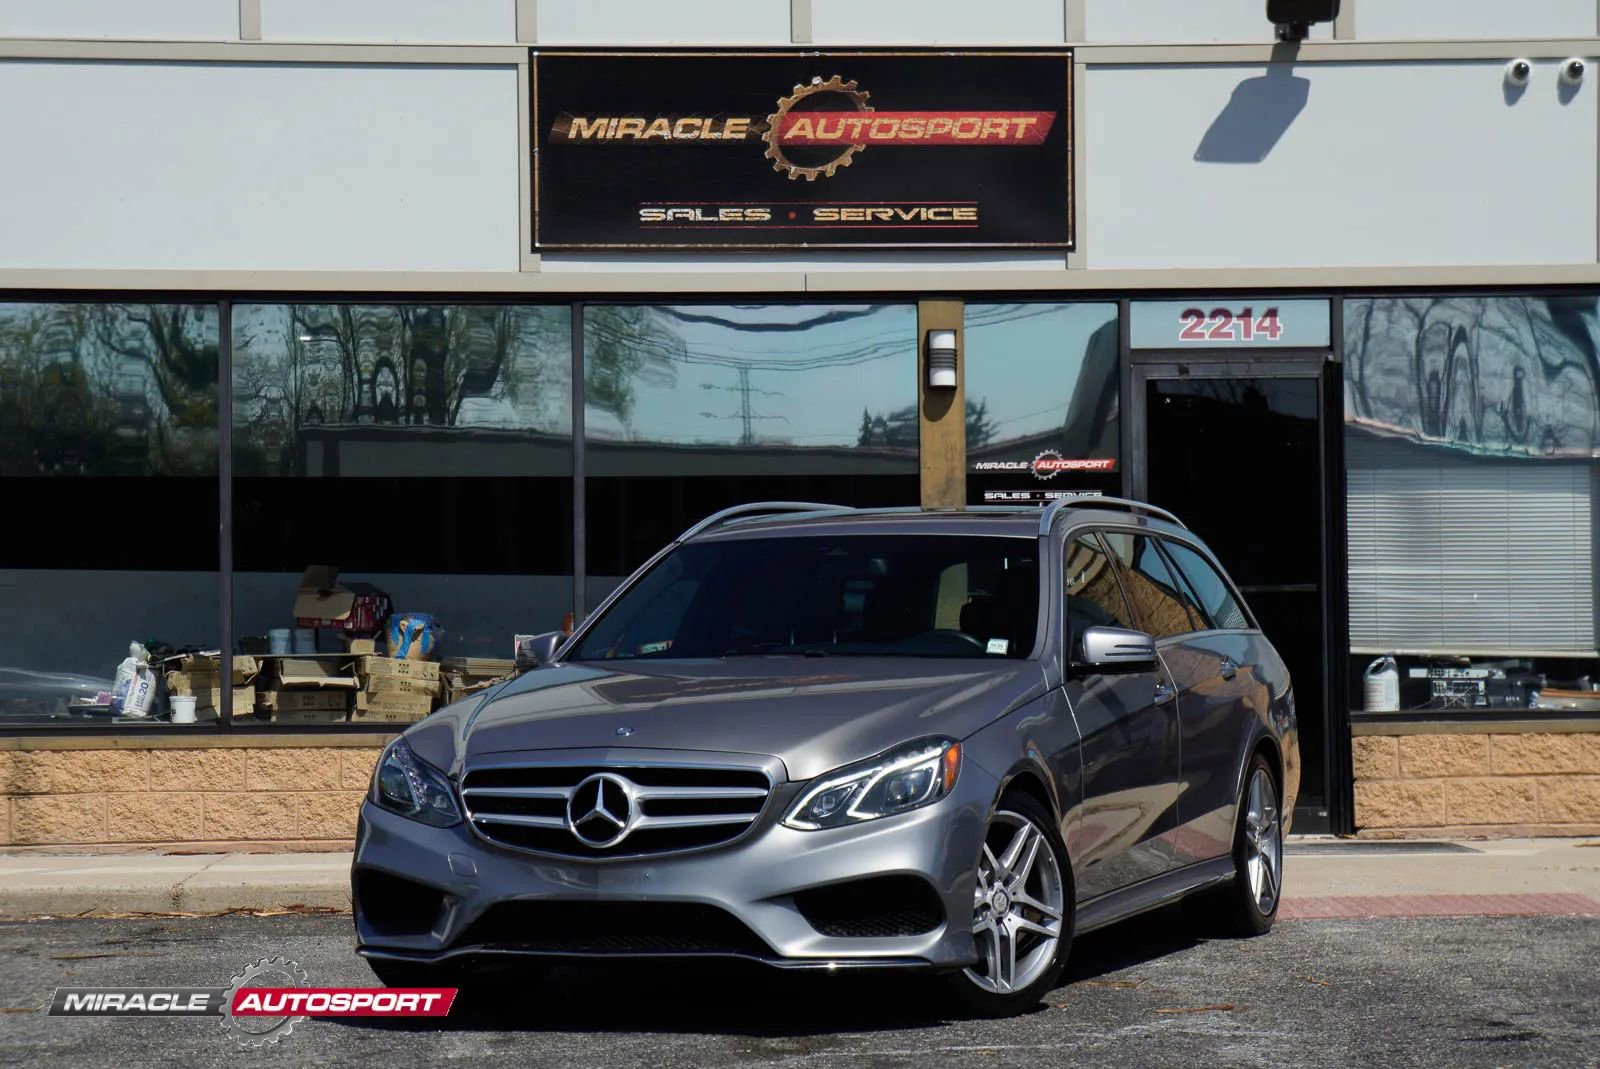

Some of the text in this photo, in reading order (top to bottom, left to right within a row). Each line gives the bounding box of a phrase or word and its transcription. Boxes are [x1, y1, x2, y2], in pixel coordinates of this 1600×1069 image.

[568, 116, 1042, 140] MIRACLE AUTOSPORT
[638, 206, 979, 222] SALES SERVICE
[1178, 306, 1284, 342] 2214
[1037, 460, 1110, 469] AUTOSPORT
[139, 682, 148, 695] 20
